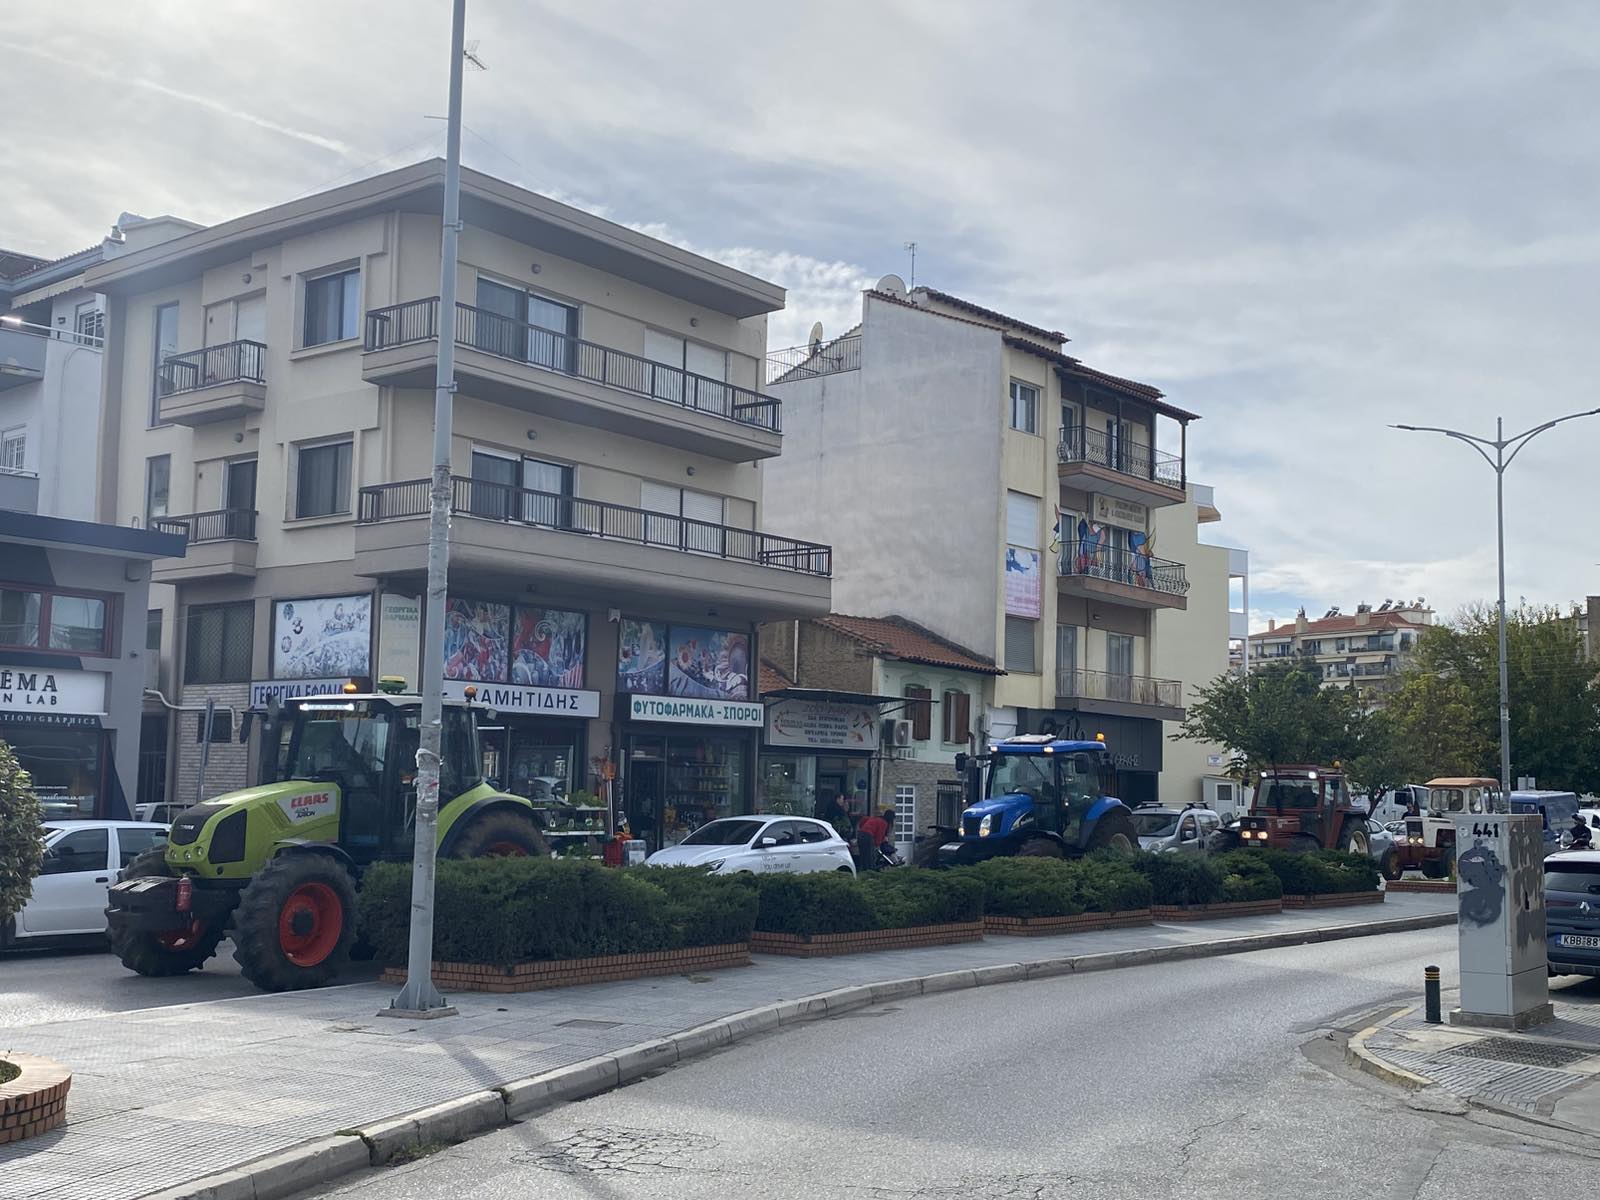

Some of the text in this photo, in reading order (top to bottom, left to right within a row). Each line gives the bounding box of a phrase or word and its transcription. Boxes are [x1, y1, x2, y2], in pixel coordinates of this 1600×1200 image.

[26, 694, 57, 705] LAB
[633, 700, 715, 719] ΦΥΤΟΦΑΡΜΑΚΑ
[723, 706, 761, 721] ΣΠΟΡΟΙ
[291, 792, 329, 809] CLAAS
[1472, 822, 1500, 838] 441
